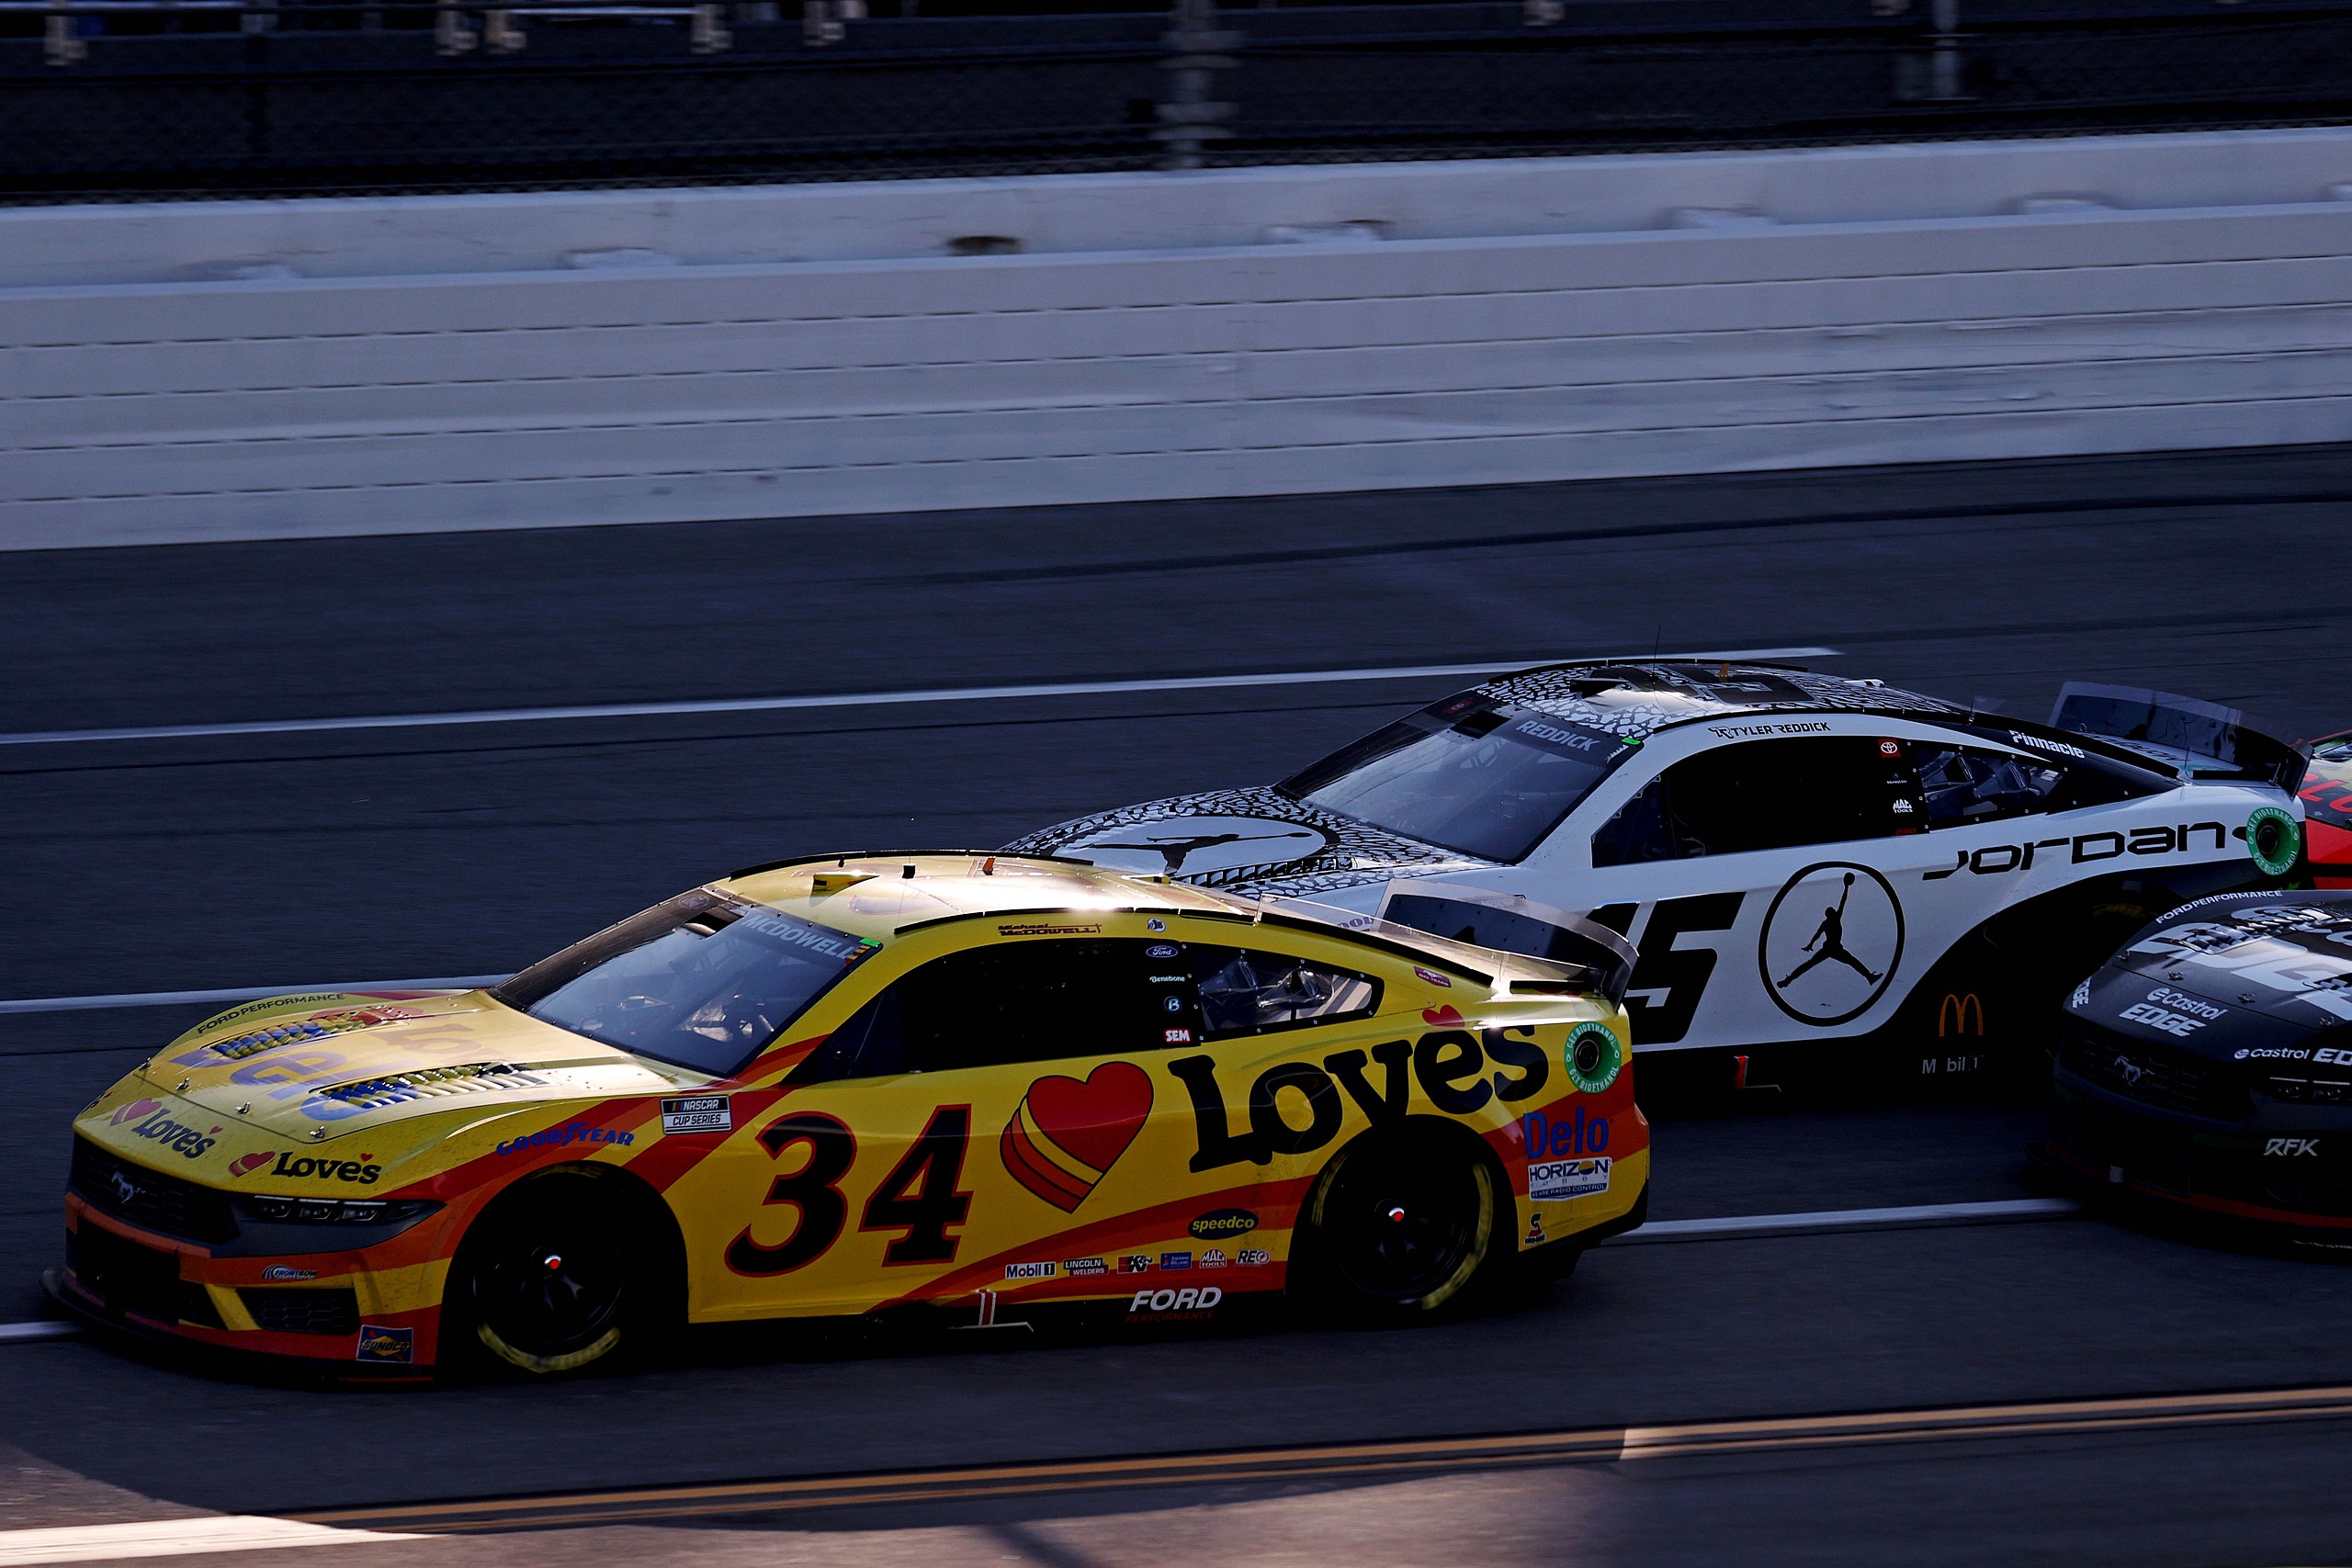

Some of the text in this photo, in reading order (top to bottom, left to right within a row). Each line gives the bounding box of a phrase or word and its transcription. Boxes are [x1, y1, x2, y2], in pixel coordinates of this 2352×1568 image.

[1516, 720, 1600, 751] REDDICK
[1731, 722, 1831, 737] TYLER REDDICK
[2008, 729, 2086, 759] Pinnacle
[741, 915, 856, 959] MCDOWELL
[2161, 992, 2230, 1021] Castrol
[2119, 1002, 2208, 1037] EDGE
[1165, 1030, 1191, 1043] SEM
[1566, 1022, 1616, 1049] GET BIOETHANOL
[2249, 1046, 2311, 1061] Castrol
[1922, 1056, 1966, 1075] Mbil
[1569, 1066, 1619, 1092] GET BIOETHANOL
[682, 1100, 719, 1111] NASCAR
[673, 1113, 721, 1126] CUP SERIES
[496, 1122, 635, 1156] GOODYEAR
[1523, 1106, 1609, 1160] Delo
[2263, 1137, 2321, 1157] RFK
[1529, 1159, 1609, 1182] HORIZON
[723, 1102, 974, 1279] 34
[1572, 1184, 1606, 1192] CONTROL
[1192, 1215, 1255, 1234] speedco
[1065, 1258, 1102, 1269] LINCOLN
[1202, 1249, 1226, 1262] MAC
[1006, 1263, 1042, 1279] Mobil
[1072, 1268, 1105, 1276] WELDERS
[1129, 1286, 1223, 1313] FORD
[1124, 1310, 1216, 1324] PERFORMANCE
[360, 1338, 411, 1352] SUNOCO
